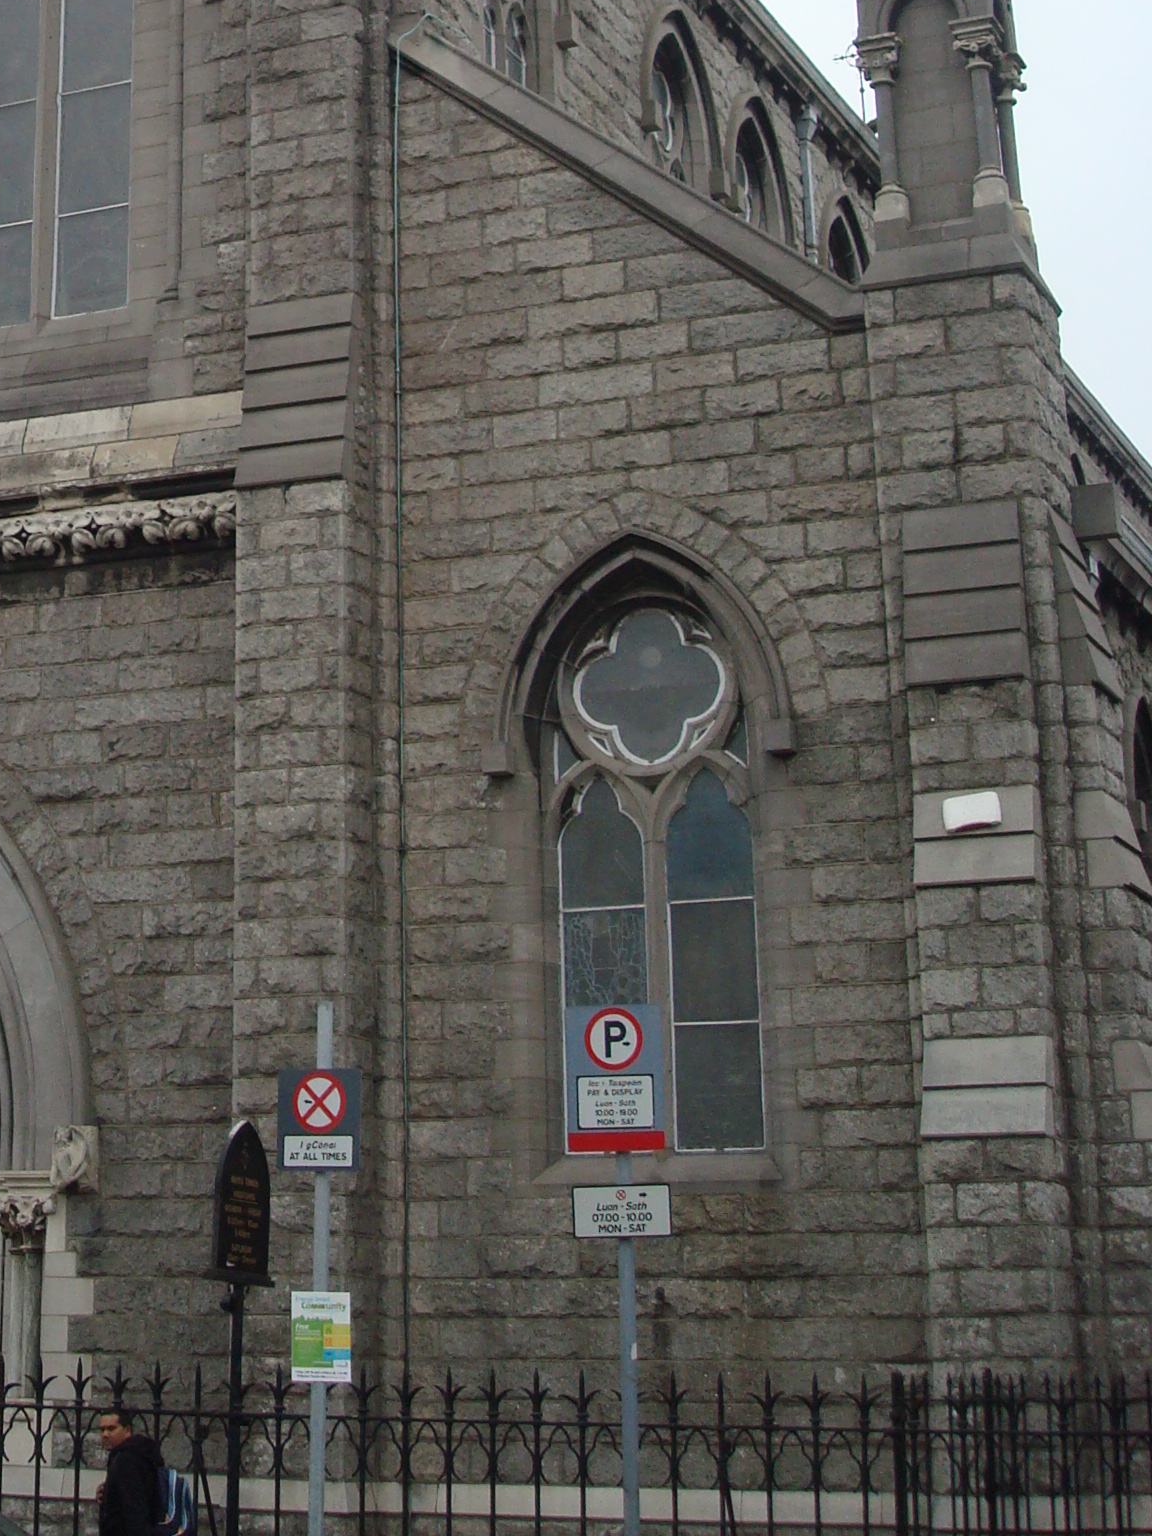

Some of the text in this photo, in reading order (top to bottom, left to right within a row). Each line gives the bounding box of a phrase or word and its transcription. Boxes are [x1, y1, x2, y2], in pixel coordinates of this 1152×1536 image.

[604, 1020, 627, 1058] P
[604, 1088, 609, 1096] &
[611, 1088, 643, 1096] DISPLAY
[289, 1152, 347, 1161] AT ALL TIMES
[598, 1224, 622, 1233] MON
[629, 1224, 646, 1233] SAT
